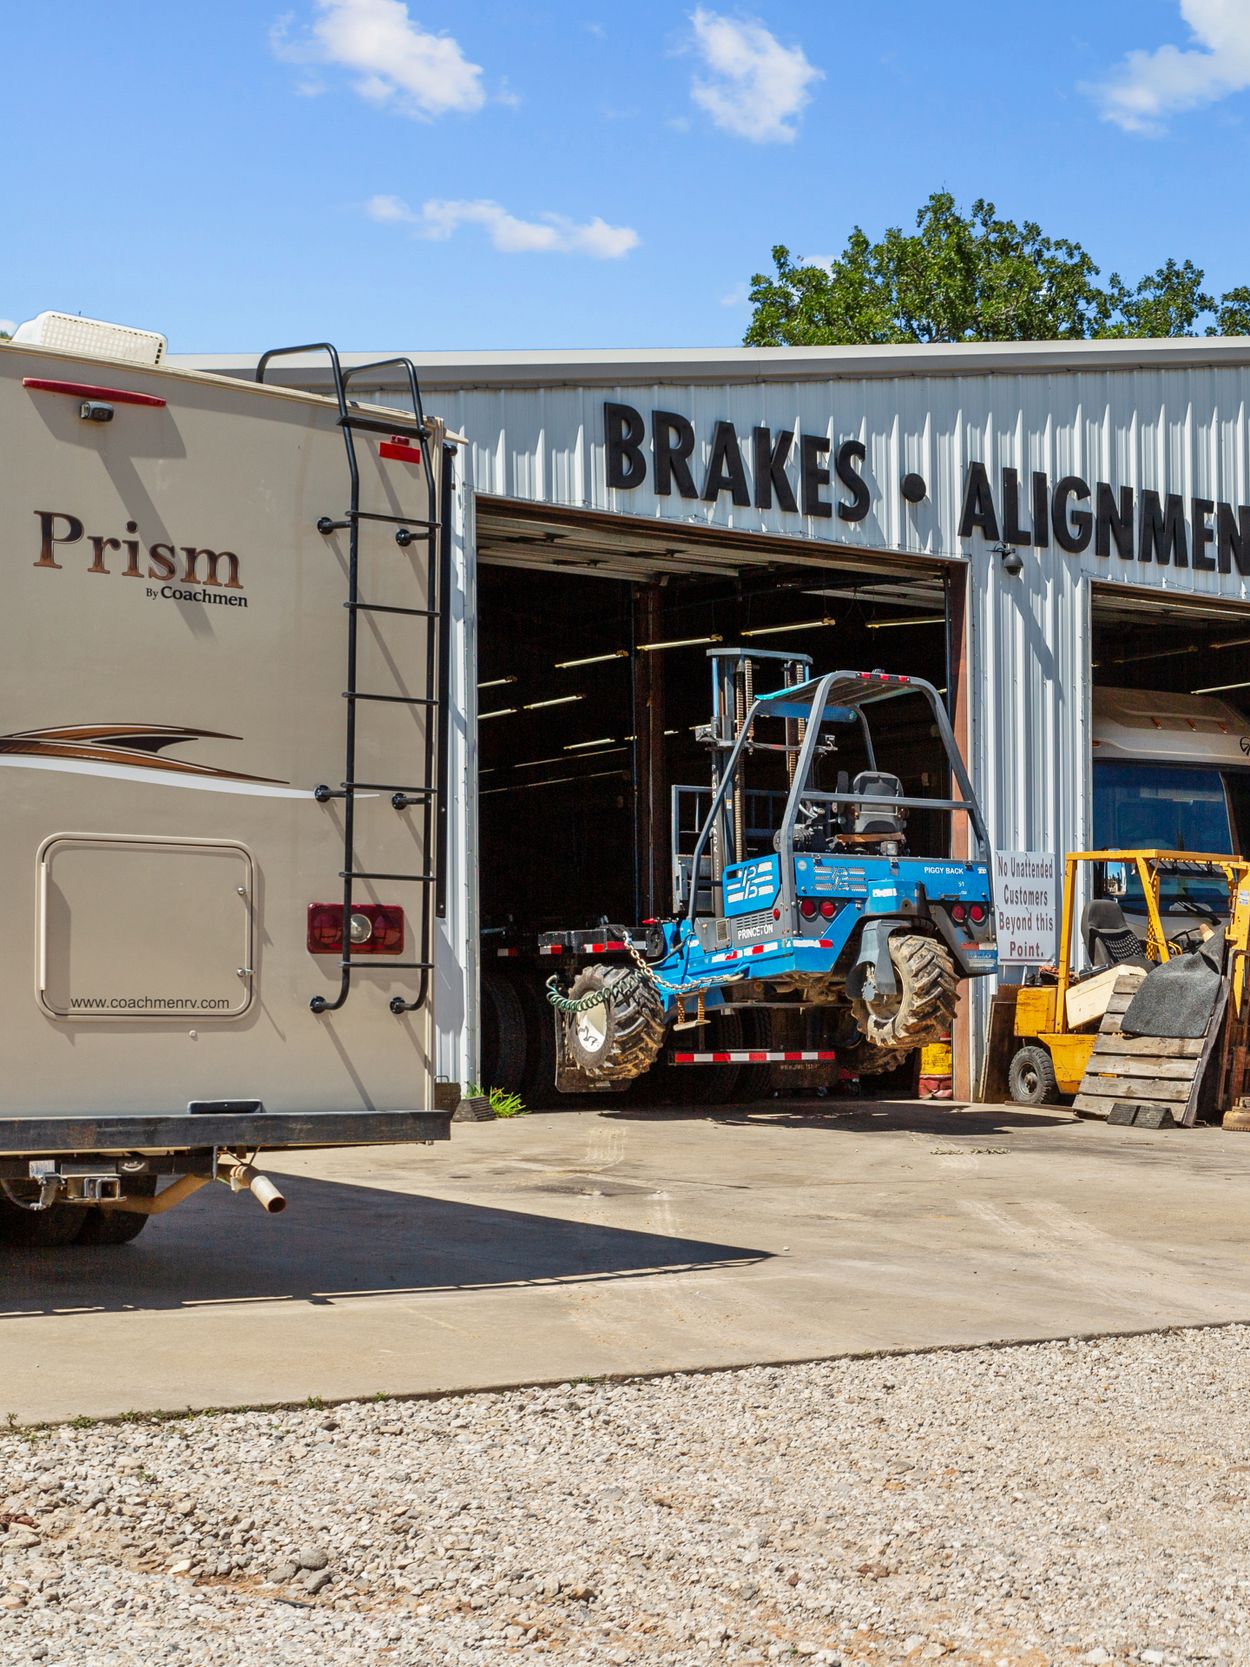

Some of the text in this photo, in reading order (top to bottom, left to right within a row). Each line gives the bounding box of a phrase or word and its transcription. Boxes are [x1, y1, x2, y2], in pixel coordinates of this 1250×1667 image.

[604, 402, 872, 523] BRAKES
[33, 510, 244, 589] Prism
[146, 586, 249, 608] By Coachmen
[924, 866, 964, 875] PIGGY BACK
[998, 856, 1053, 879] No Unattended
[1003, 884, 1048, 906] Customers
[737, 924, 774, 940] PRINCETON
[999, 911, 1054, 935] Beyond this
[1010, 941, 1044, 957] Point.
[70, 996, 230, 1009] www.coachmenrv.com
